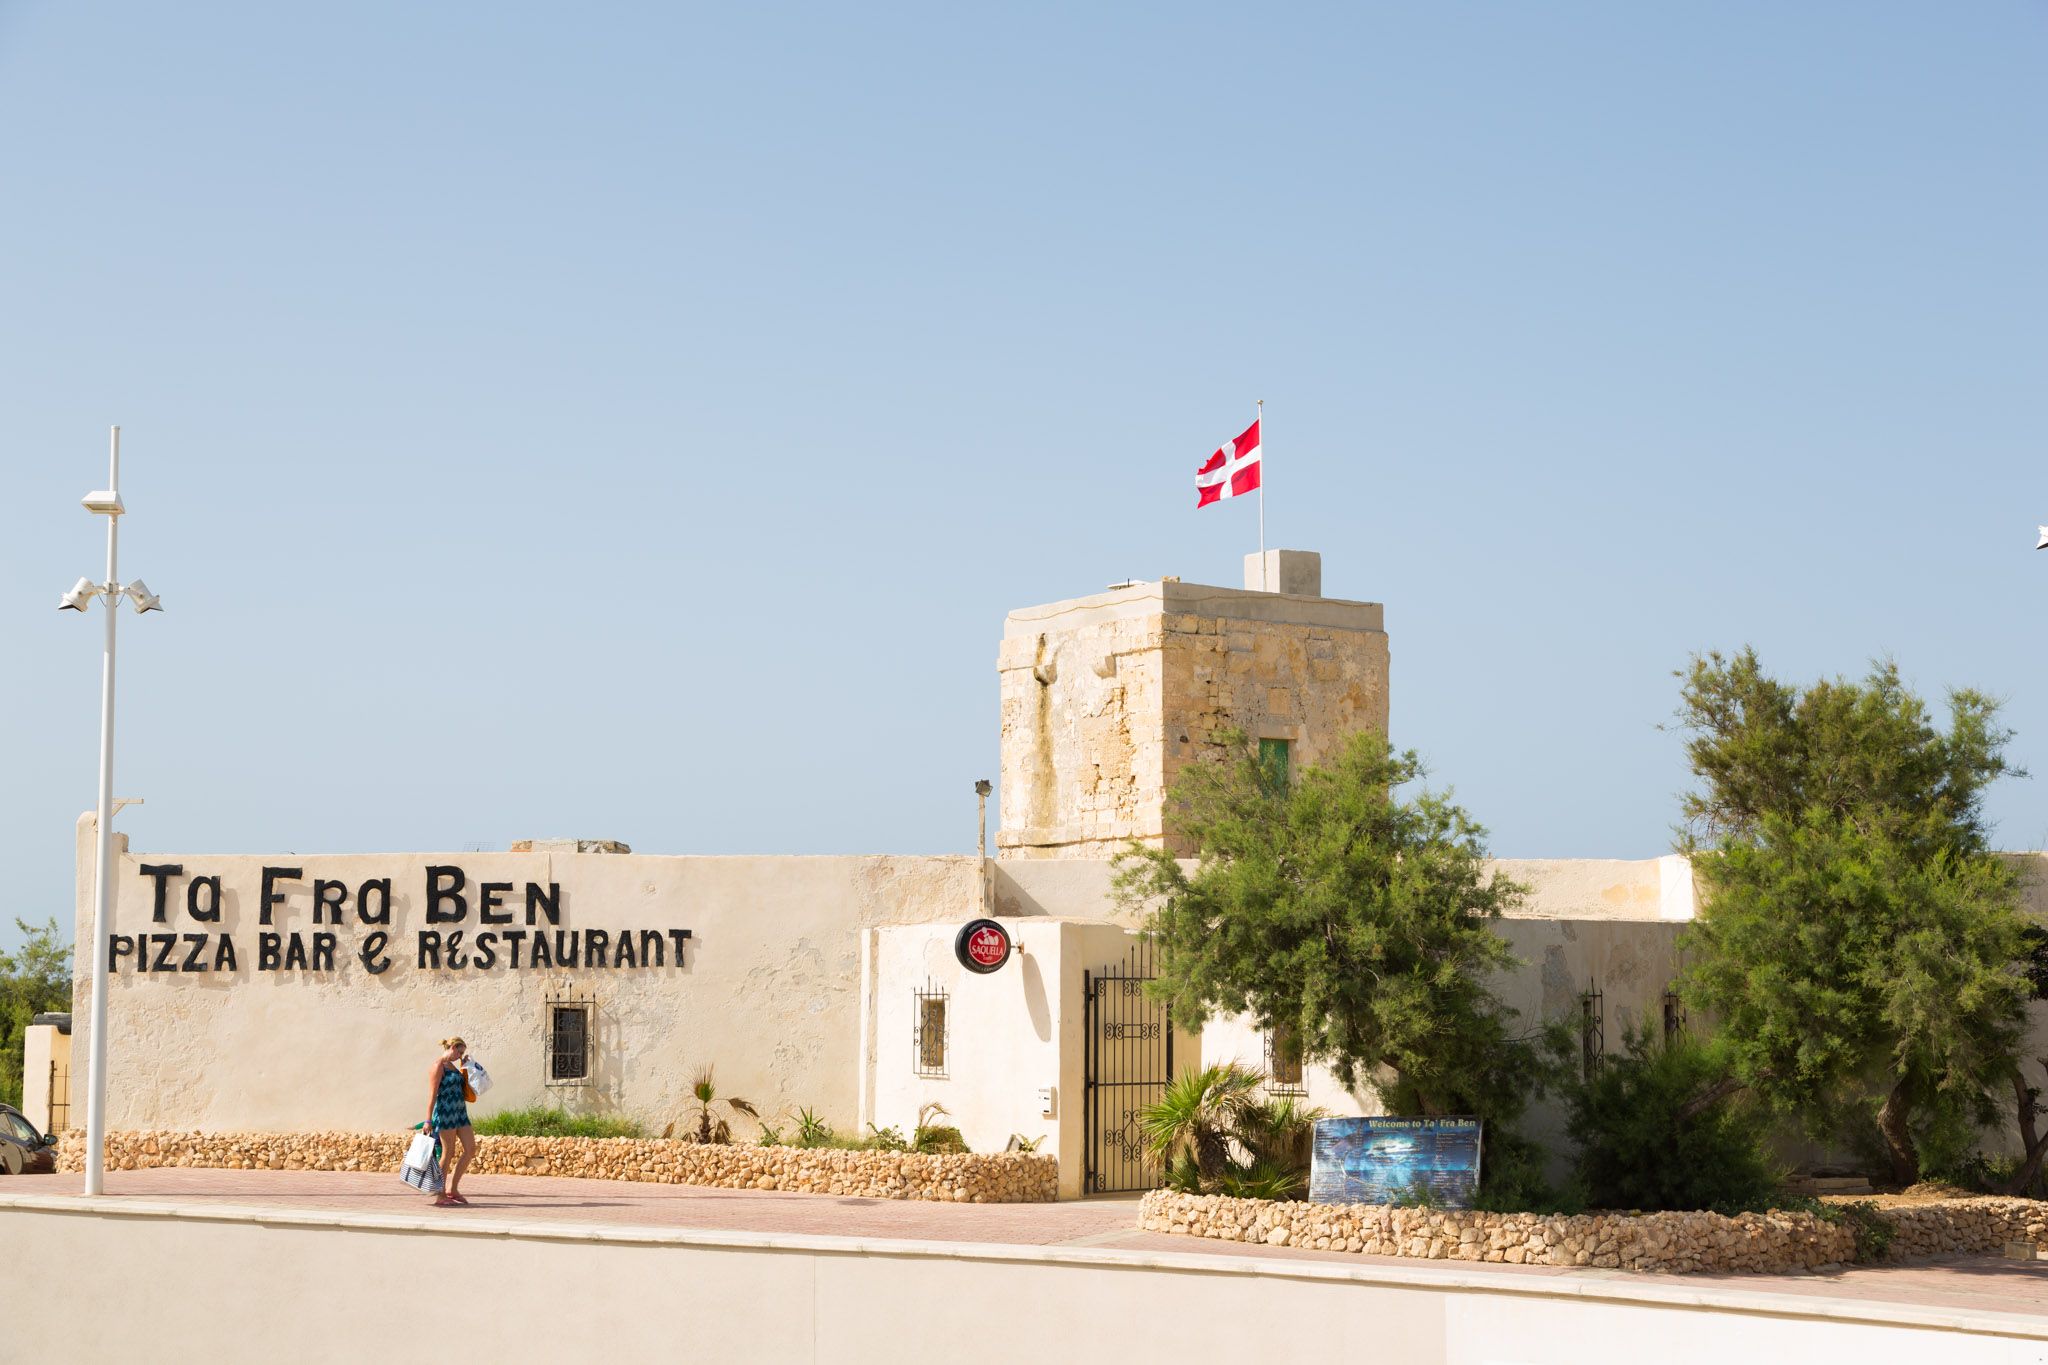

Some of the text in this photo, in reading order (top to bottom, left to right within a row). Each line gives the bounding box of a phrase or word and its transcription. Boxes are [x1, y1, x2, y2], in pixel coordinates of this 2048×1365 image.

[140, 864, 221, 923] Ta
[108, 933, 237, 973] PIZZA
[258, 932, 337, 971] BAR
[972, 945, 1003, 956] SAQUELLA
[1368, 1119, 1410, 1128] Welcome
[1412, 1119, 1421, 1128] to
[1440, 1119, 1455, 1128] Fra
[1458, 1118, 1476, 1127] Ben
